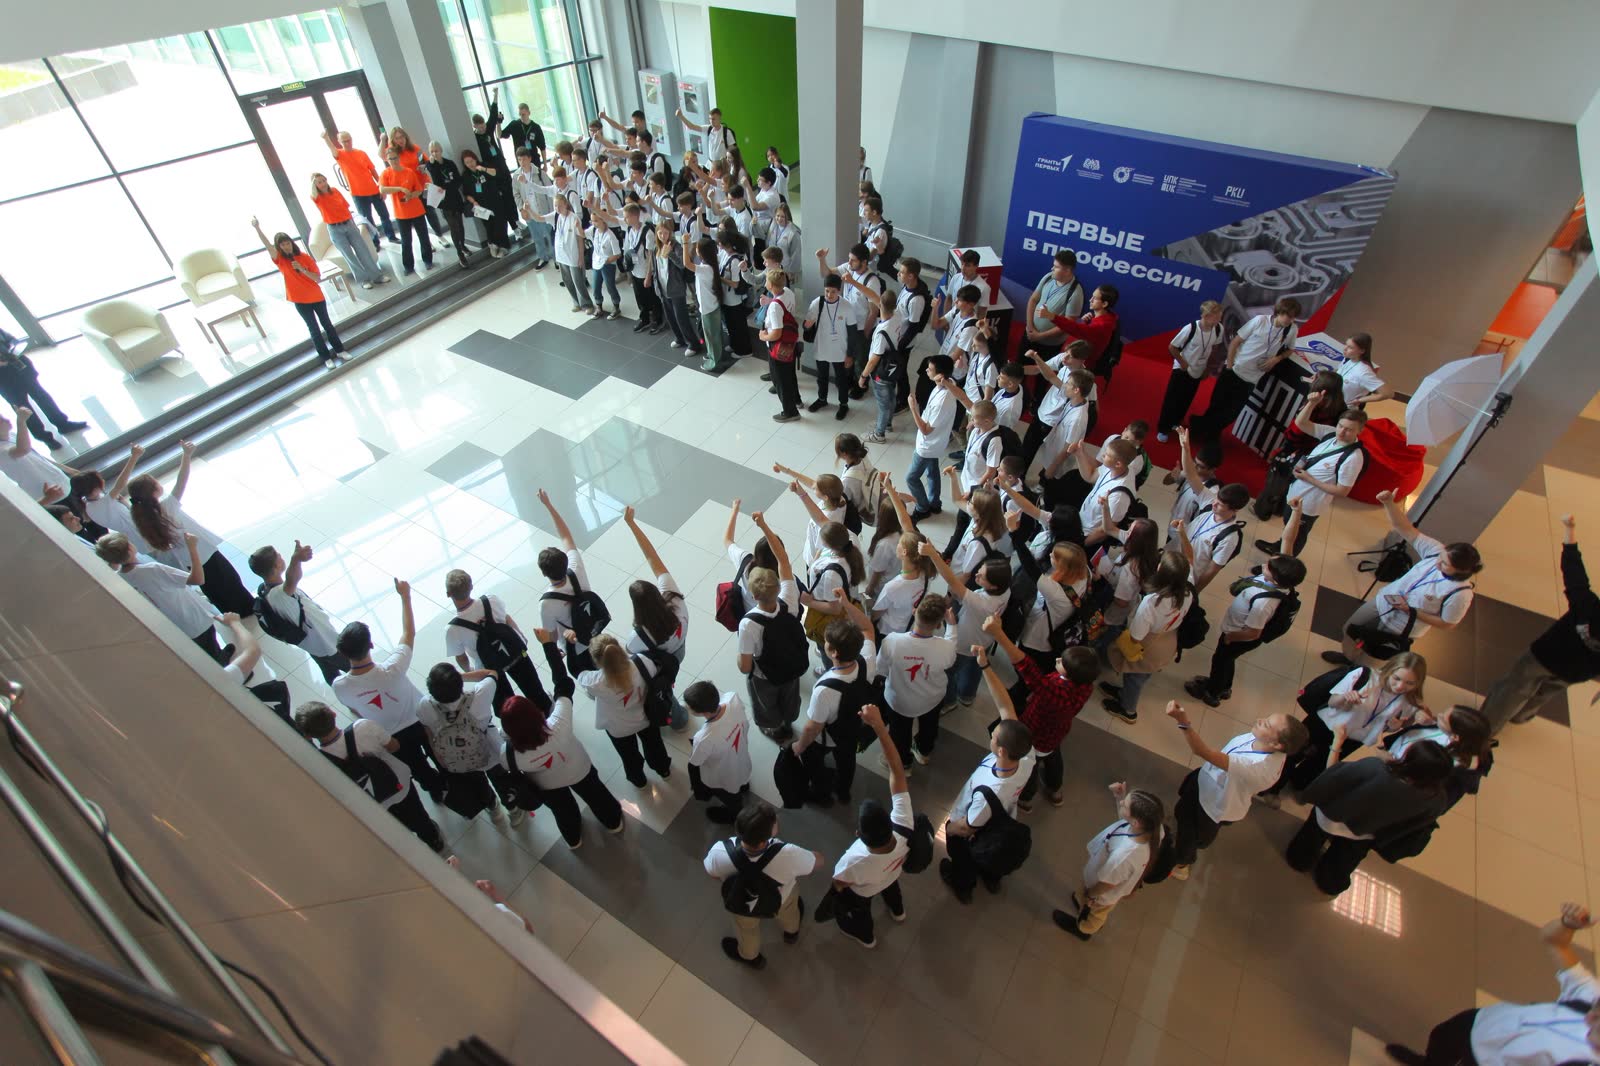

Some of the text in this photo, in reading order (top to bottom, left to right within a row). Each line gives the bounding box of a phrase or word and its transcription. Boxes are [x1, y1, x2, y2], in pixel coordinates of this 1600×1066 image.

[1037, 157, 1061, 166] ГРАНТЫ
[1035, 163, 1060, 172] ПЕРВЫХ
[1026, 210, 1145, 252] ПЕРВЫЕ
[1022, 237, 1037, 251] в
